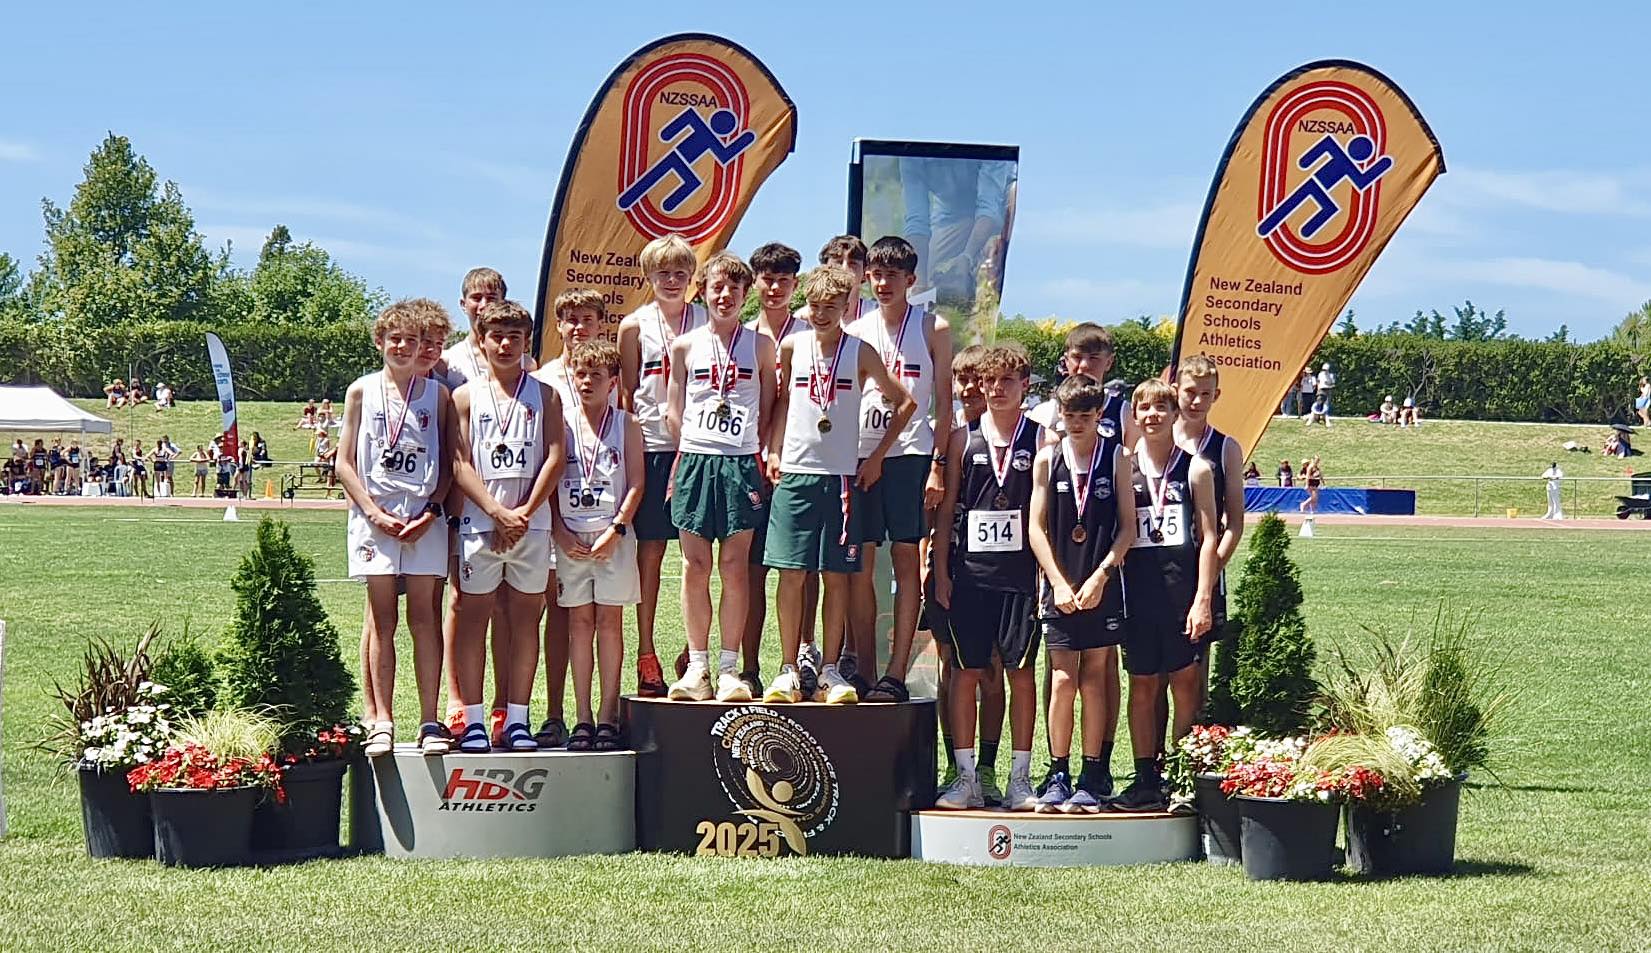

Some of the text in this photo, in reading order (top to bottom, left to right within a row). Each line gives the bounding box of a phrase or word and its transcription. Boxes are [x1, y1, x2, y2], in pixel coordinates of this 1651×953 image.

[660, 91, 718, 108] NZSSAA
[1298, 120, 1355, 135] NZSSAA
[570, 250, 641, 267] New Zeal
[566, 269, 645, 290] Secondary
[1210, 277, 1303, 296] New Zealand
[1205, 296, 1283, 316] Secondary
[1203, 314, 1261, 330] Schools
[1199, 333, 1261, 350] Athletics
[697, 408, 743, 436] 1066
[864, 409, 893, 430] 106
[380, 448, 417, 473] 596
[491, 447, 526, 469] 604
[978, 521, 1013, 542] 514
[711, 707, 742, 737] TRACK
[748, 706, 779, 717] FIELD
[439, 802, 537, 812] ATHLETICS
[696, 821, 780, 857] 2025
[1054, 833, 1086, 842] Secondary
